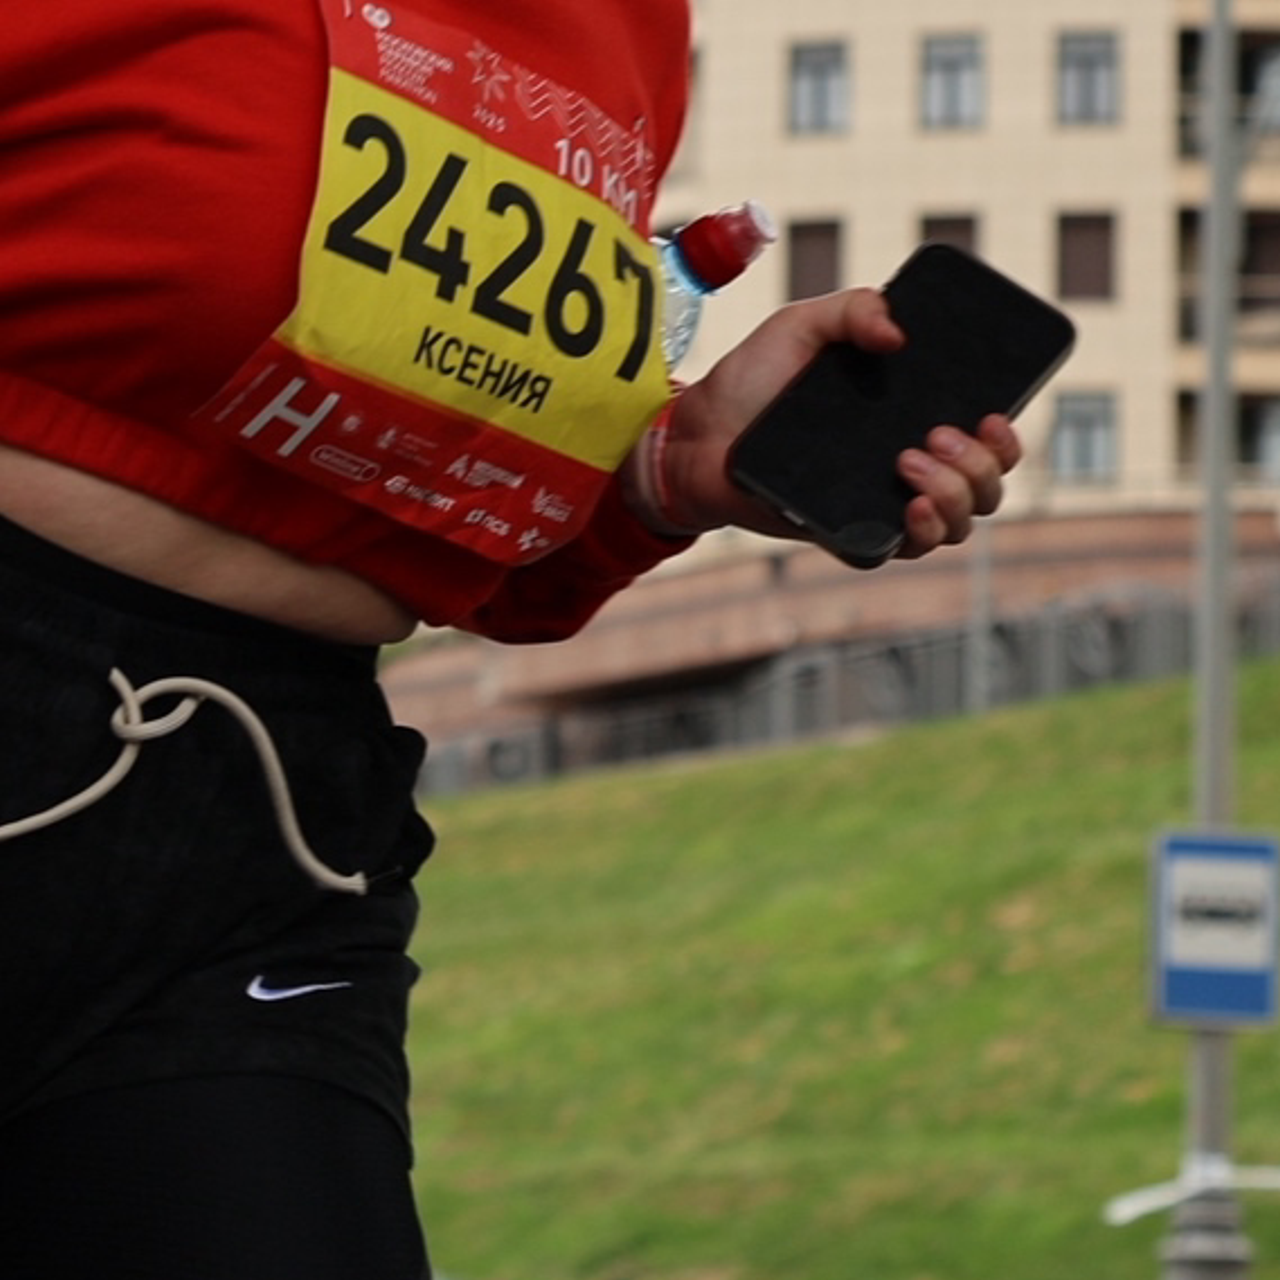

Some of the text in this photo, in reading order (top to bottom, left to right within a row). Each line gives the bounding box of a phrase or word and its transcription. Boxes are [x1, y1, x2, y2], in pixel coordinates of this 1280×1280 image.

[554, 138, 594, 188] 10
[322, 113, 656, 383] 24267
[413, 326, 552, 414] КСЕНИЯ
